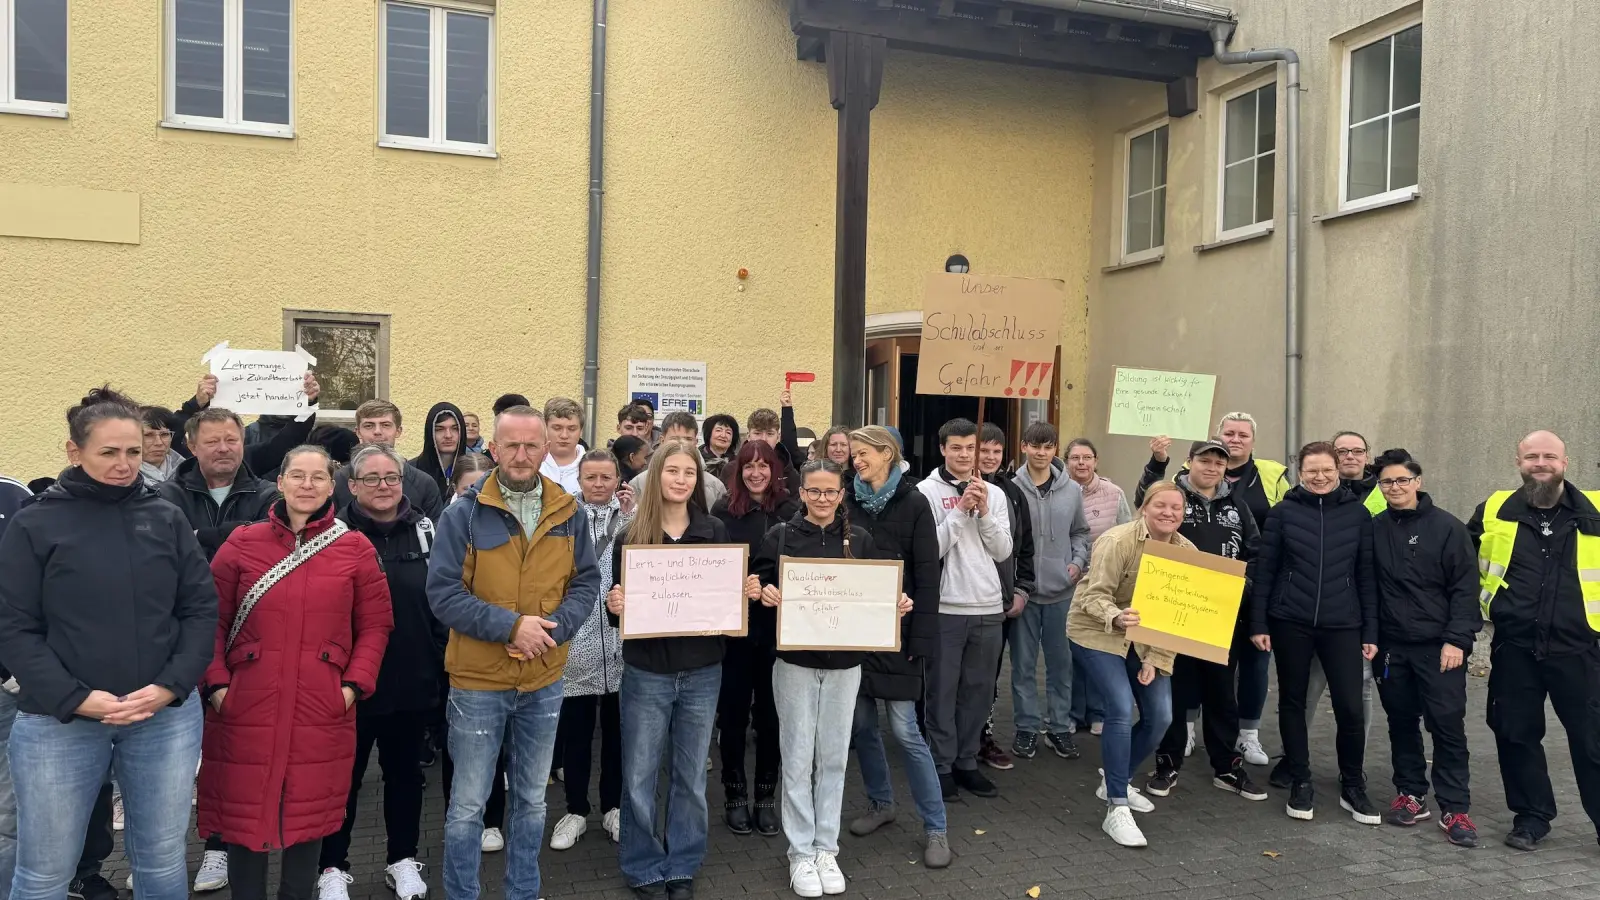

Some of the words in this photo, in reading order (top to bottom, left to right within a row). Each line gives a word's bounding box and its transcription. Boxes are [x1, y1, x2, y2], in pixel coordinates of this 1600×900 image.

[961, 276, 1008, 294] Unser
[924, 312, 1047, 341] Schulabschluss
[221, 358, 286, 372] Lehrermangel
[938, 362, 1001, 394] Gefahr
[1117, 371, 1147, 384] Bildung
[235, 392, 260, 403] jetzt
[1133, 388, 1158, 398] gesunde
[662, 398, 688, 407] EFRE
[1114, 401, 1130, 409] und
[667, 558, 684, 568] und
[787, 569, 838, 582] Qualitativer
[1144, 560, 1190, 582] Dringende
[651, 588, 693, 600] zulassen
[803, 584, 863, 597] Schulabschluss
[1146, 592, 1160, 601] des
[812, 601, 840, 616] Gefahr
